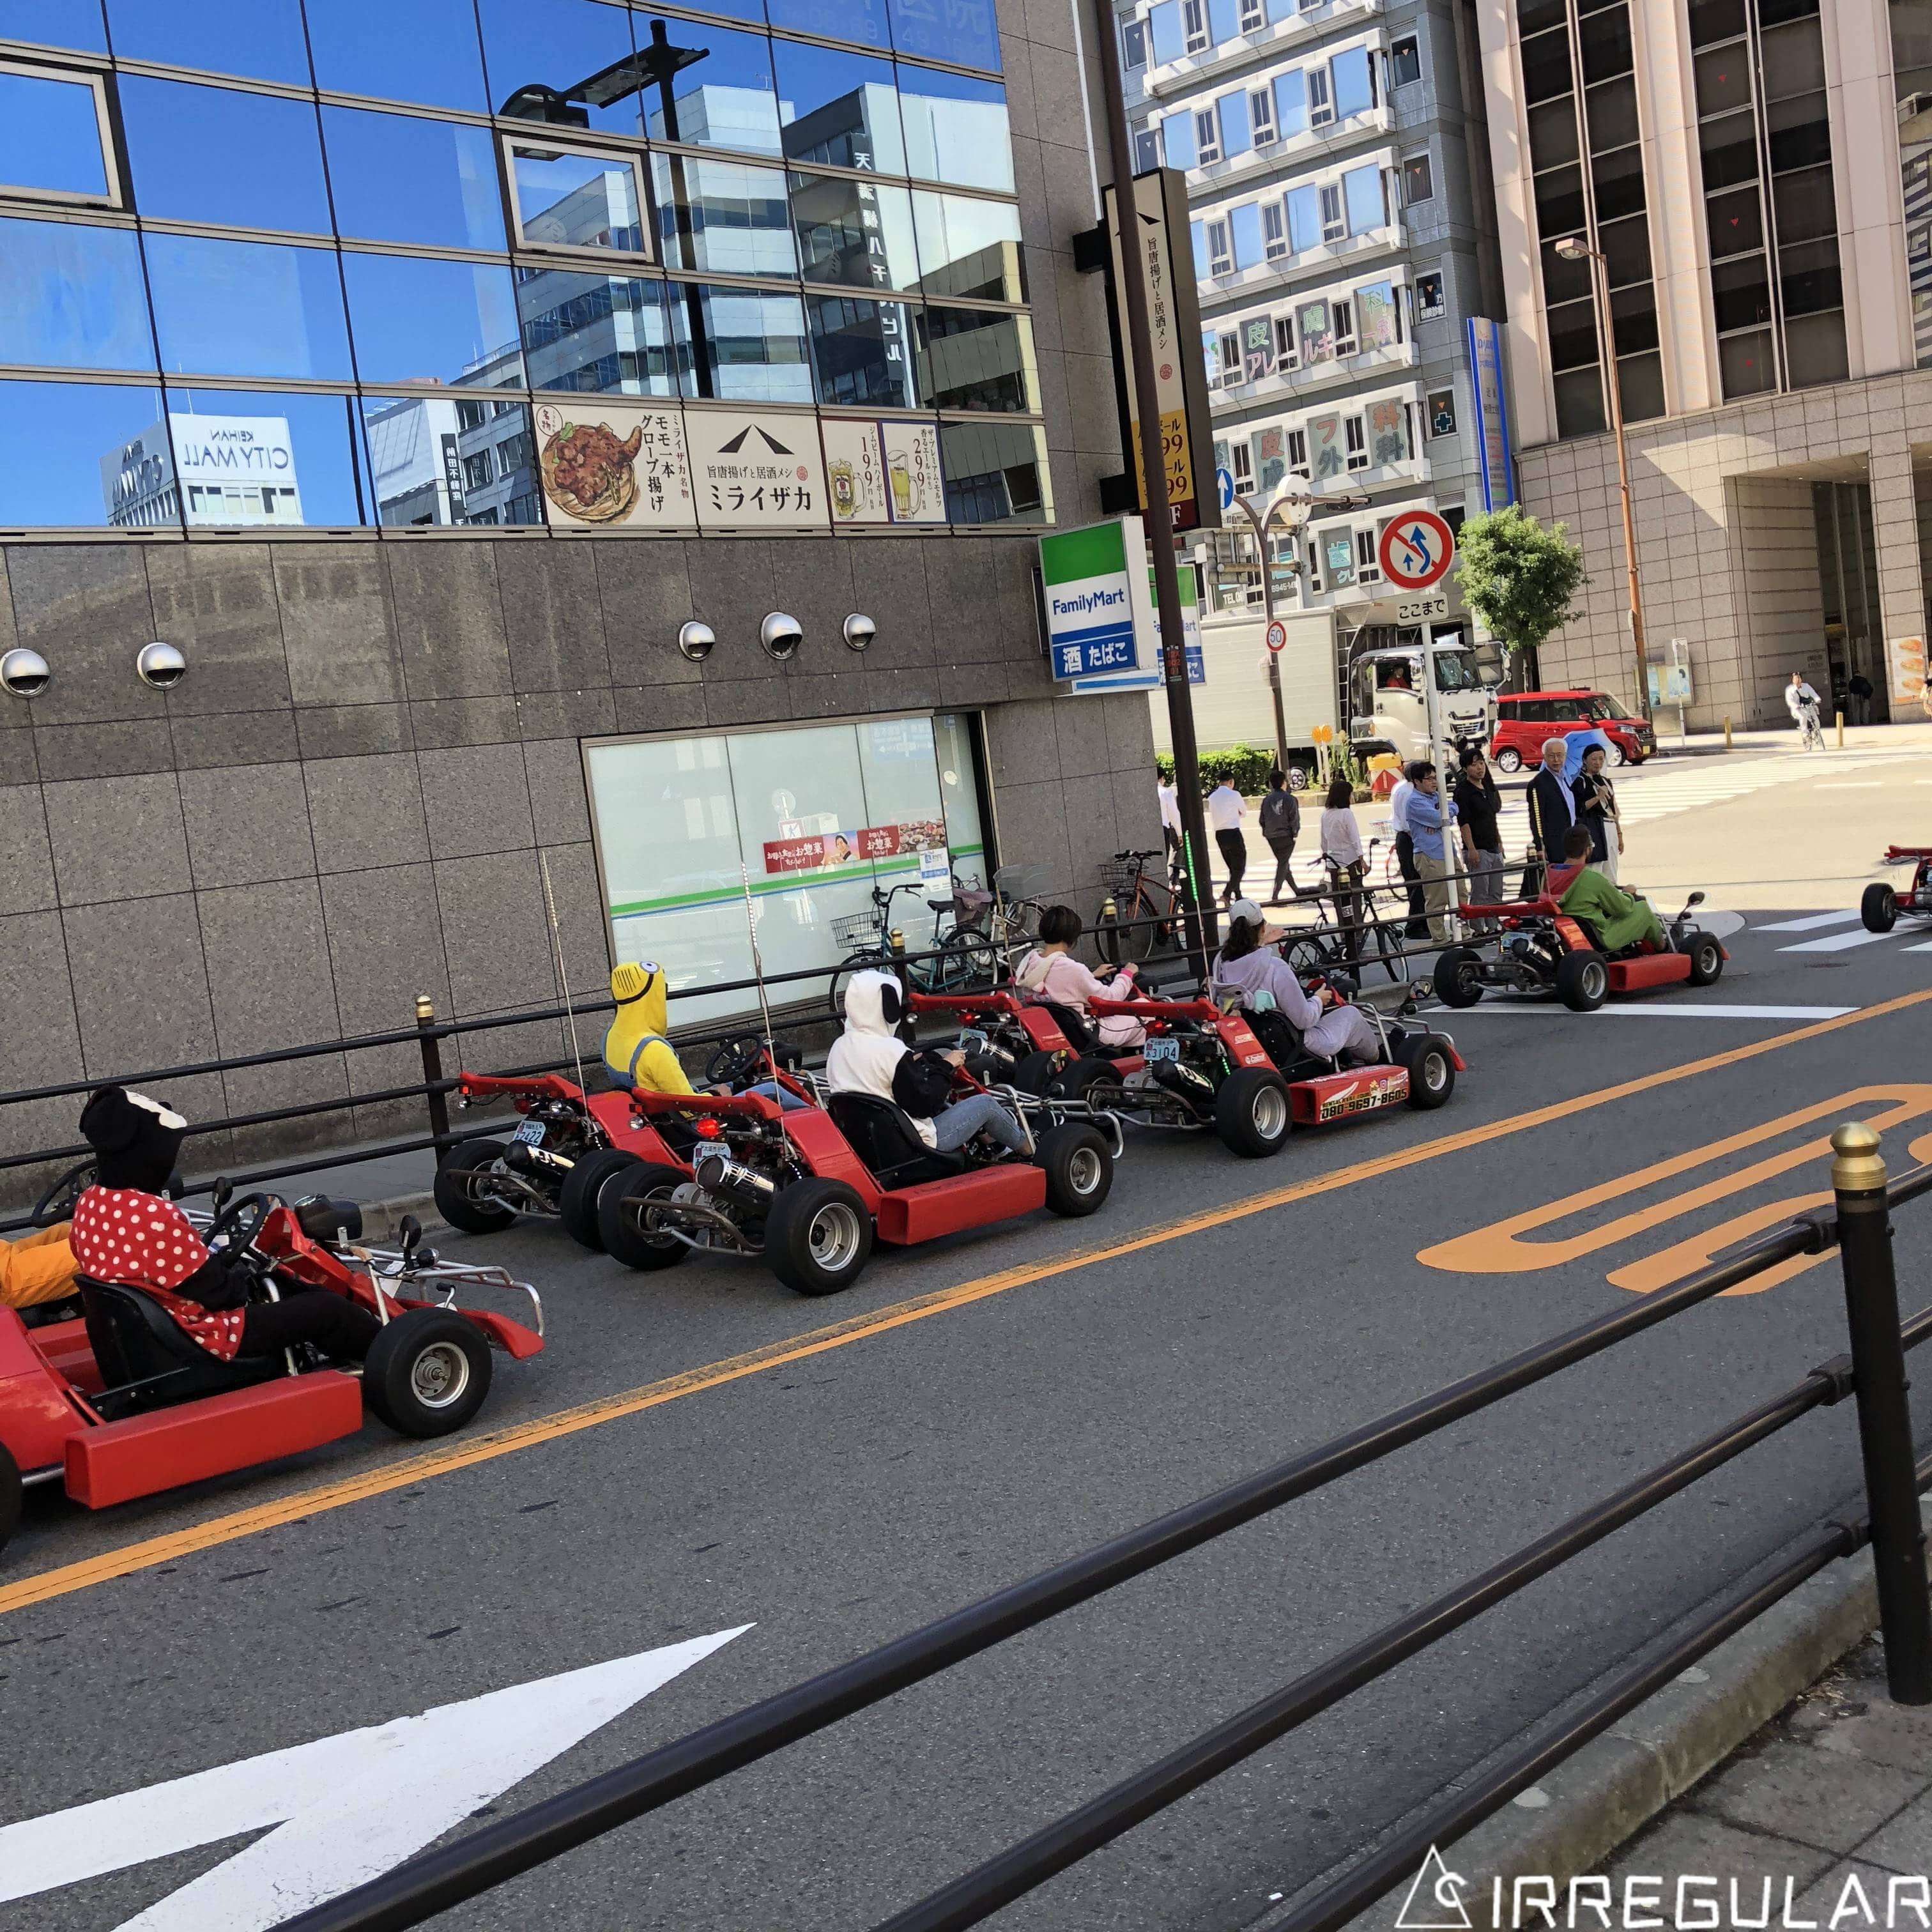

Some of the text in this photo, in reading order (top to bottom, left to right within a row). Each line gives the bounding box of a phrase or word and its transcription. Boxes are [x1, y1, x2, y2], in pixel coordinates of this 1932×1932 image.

[1147, 237, 1168, 349] 旨唐揚げと居酒メシ
[656, 416, 675, 479] モモ一本
[641, 415, 664, 512] グローブ揚げ
[707, 465, 793, 479] 旨唐揚げと居酒メシ
[710, 485, 811, 511] ミライザカ
[1052, 588, 1124, 615] FamilyMart
[1399, 599, 1445, 619] ここまで
[1270, 629, 1282, 643] 50
[1063, 641, 1128, 673] 酒 たばこ
[1321, 1088, 1408, 1119] 080-9697-8605
